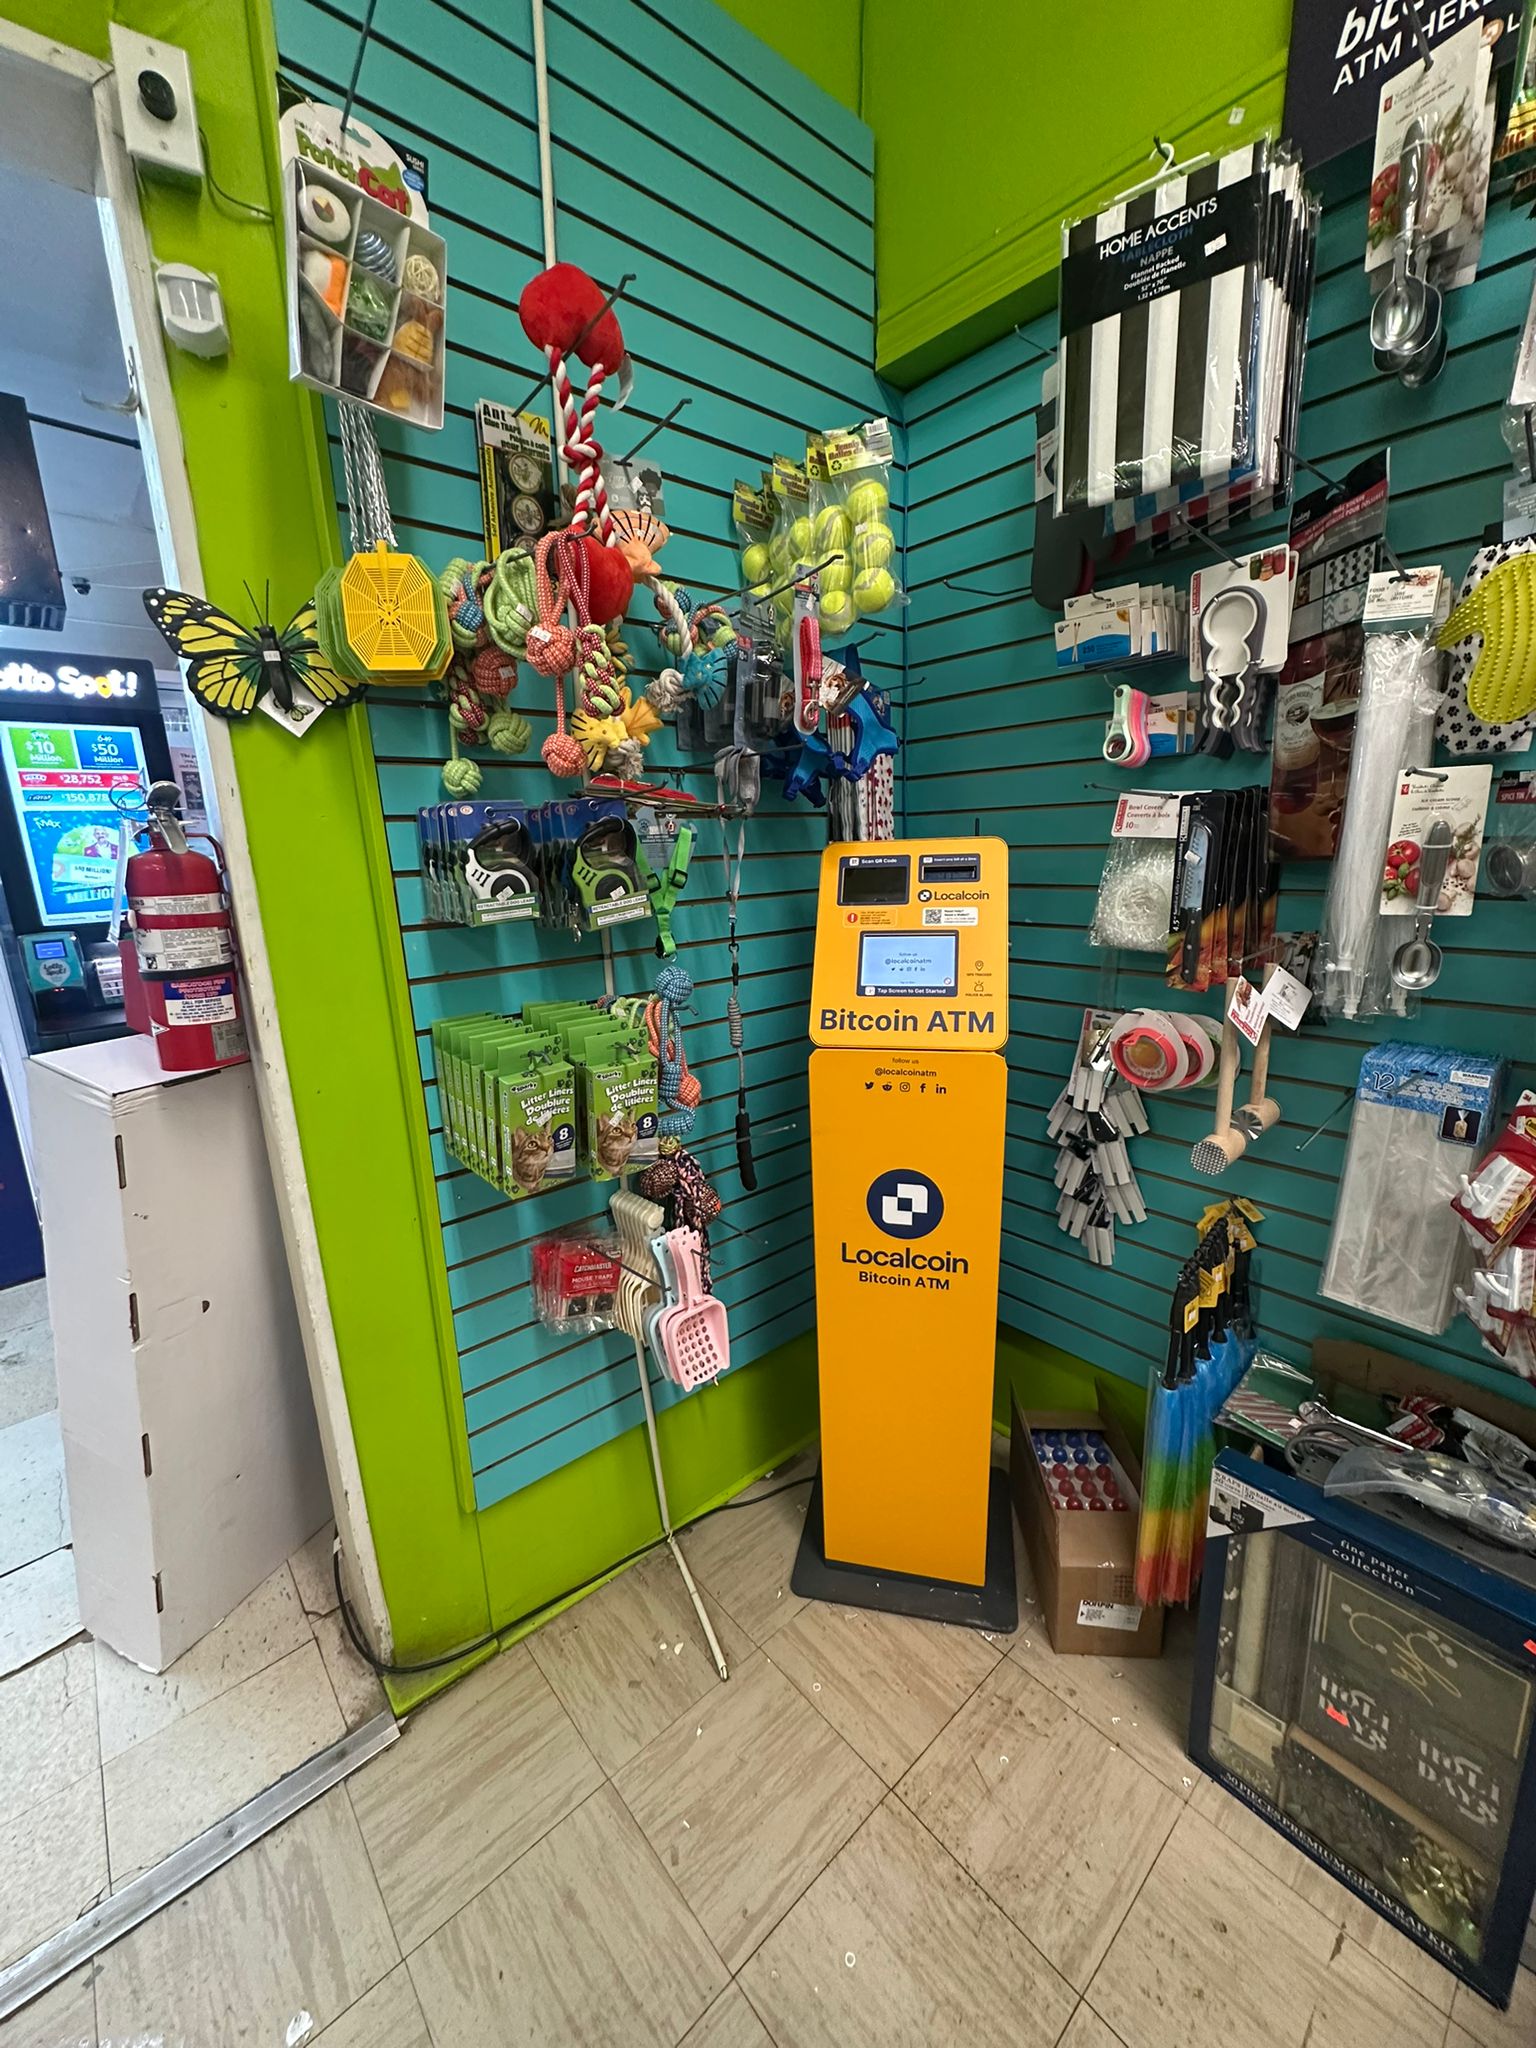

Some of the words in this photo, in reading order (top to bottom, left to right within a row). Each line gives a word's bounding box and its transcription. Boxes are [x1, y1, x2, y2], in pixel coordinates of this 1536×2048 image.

[1332, 31, 1403, 95] ATM
[358, 166, 410, 216] Cat
[1100, 229, 1143, 261] HOME
[1145, 196, 1218, 242] ACCENTS
[1120, 225, 1194, 263] TABLECLOTH
[1139, 246, 1174, 267] NAPPE
[1130, 266, 1156, 280] Flannel
[1155, 255, 1180, 271] Backed
[1151, 271, 1160, 280] de
[483, 403, 506, 422] Ant
[56, 665, 138, 699] Spot!
[25, 741, 56, 755] $10
[91, 744, 119, 756] $50
[60, 774, 103, 784] $28,752
[1125, 821, 1134, 829] 10
[934, 890, 990, 901] Localcoin
[820, 1008, 919, 1032] Bitcoin
[926, 1010, 994, 1033] ATM
[874, 1067, 937, 1078] @localcoinatm
[1373, 1070, 1395, 1092] 12
[1461, 1072, 1489, 1082] WARNING
[605, 1081, 632, 1097] Litter
[632, 1077, 658, 1088] Liners
[610, 1087, 655, 1103] Doublure
[520, 1092, 547, 1109] Litter
[548, 1088, 574, 1099] Liners
[526, 1097, 571, 1117] Doublure
[610, 1102, 622, 1113] de
[642, 1116, 653, 1129] 8
[559, 1127, 569, 1141] 8
[574, 1261, 612, 1273] CATCHMASTER
[841, 1242, 969, 1275] Localcoin
[571, 1275, 593, 1284] MOUSE
[594, 1273, 614, 1281] TRAPS
[858, 1271, 911, 1287] Bitcoin
[915, 1276, 950, 1291] ATM
[1214, 1470, 1241, 1488] WRAPS
[1340, 1539, 1366, 1557] fine
[1370, 1556, 1409, 1580] paper
[1332, 1548, 1415, 1596] collection
[1282, 1816, 1346, 1873] PREMIUM
[1428, 1931, 1457, 1957] KIT
